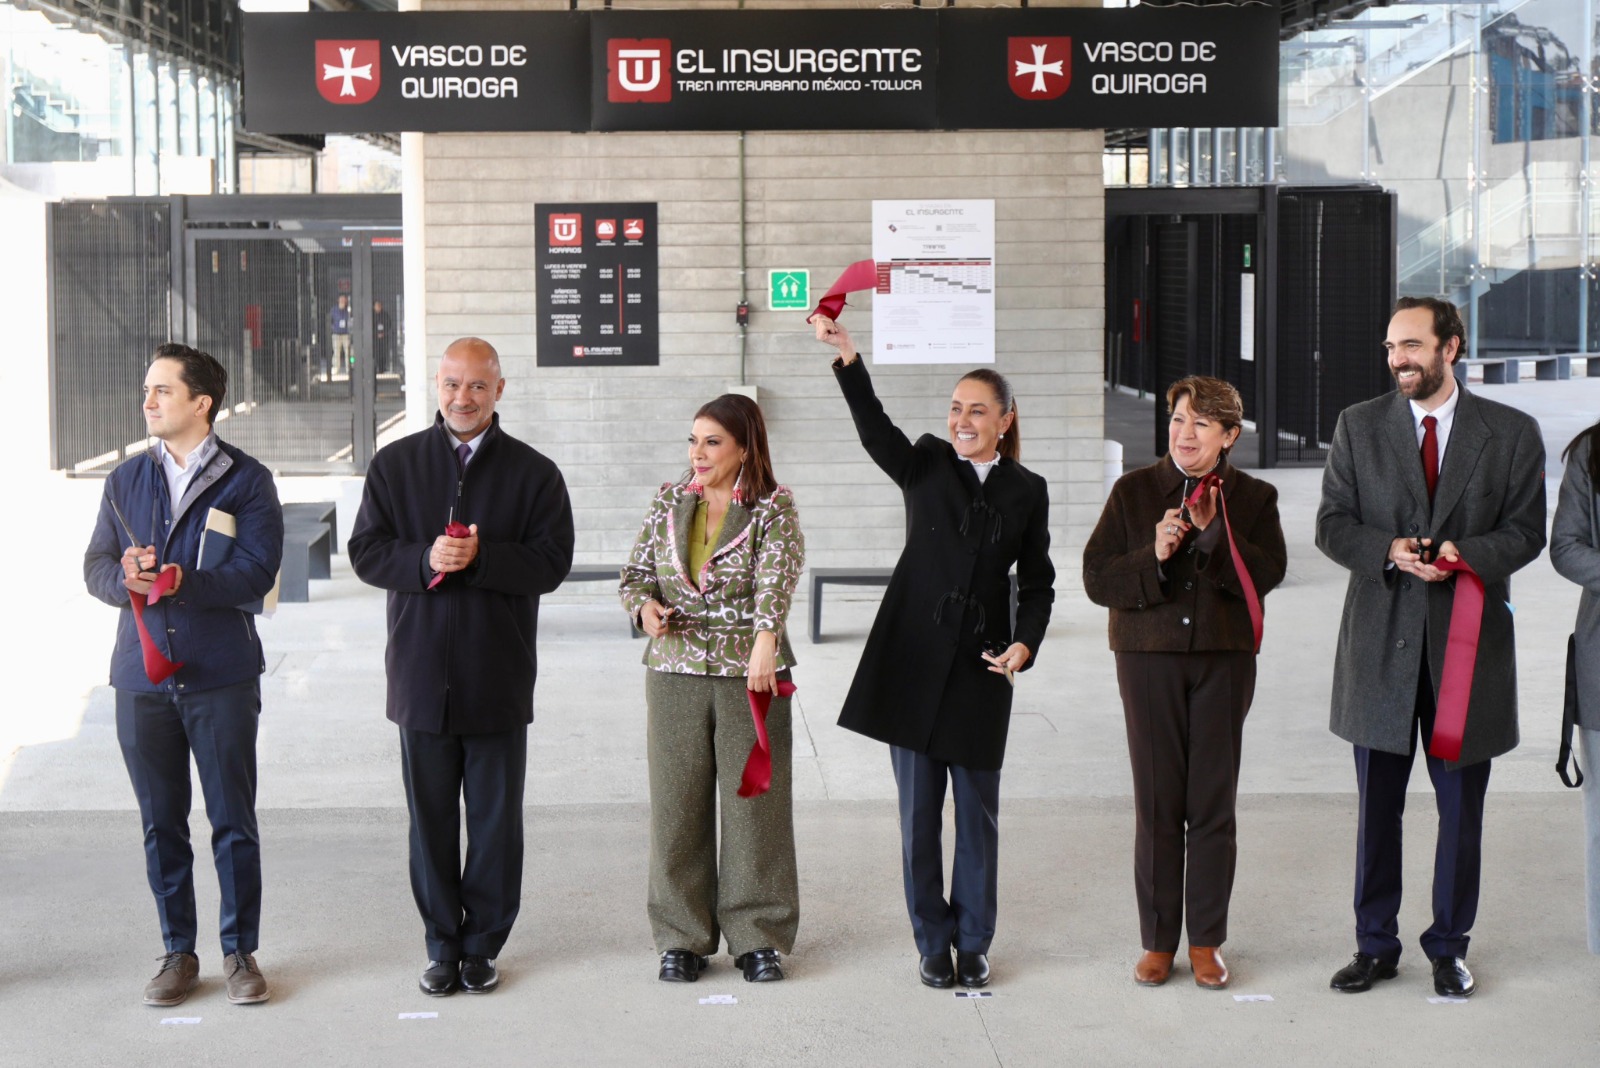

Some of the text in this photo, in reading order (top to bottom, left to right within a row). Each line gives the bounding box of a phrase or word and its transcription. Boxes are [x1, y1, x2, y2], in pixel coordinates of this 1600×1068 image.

[391, 44, 527, 67] VASCO DE
[676, 47, 923, 74] EL INSURGENTE
[1083, 41, 1217, 63] VASCO DE
[400, 76, 519, 99] QUIROGA
[677, 80, 714, 92] TREN
[716, 80, 810, 92] INTERURBANO
[811, 77, 862, 91] MÉXICO
[1091, 73, 1207, 95] QUIROGA
[917, 208, 964, 216] INSURGENTE
